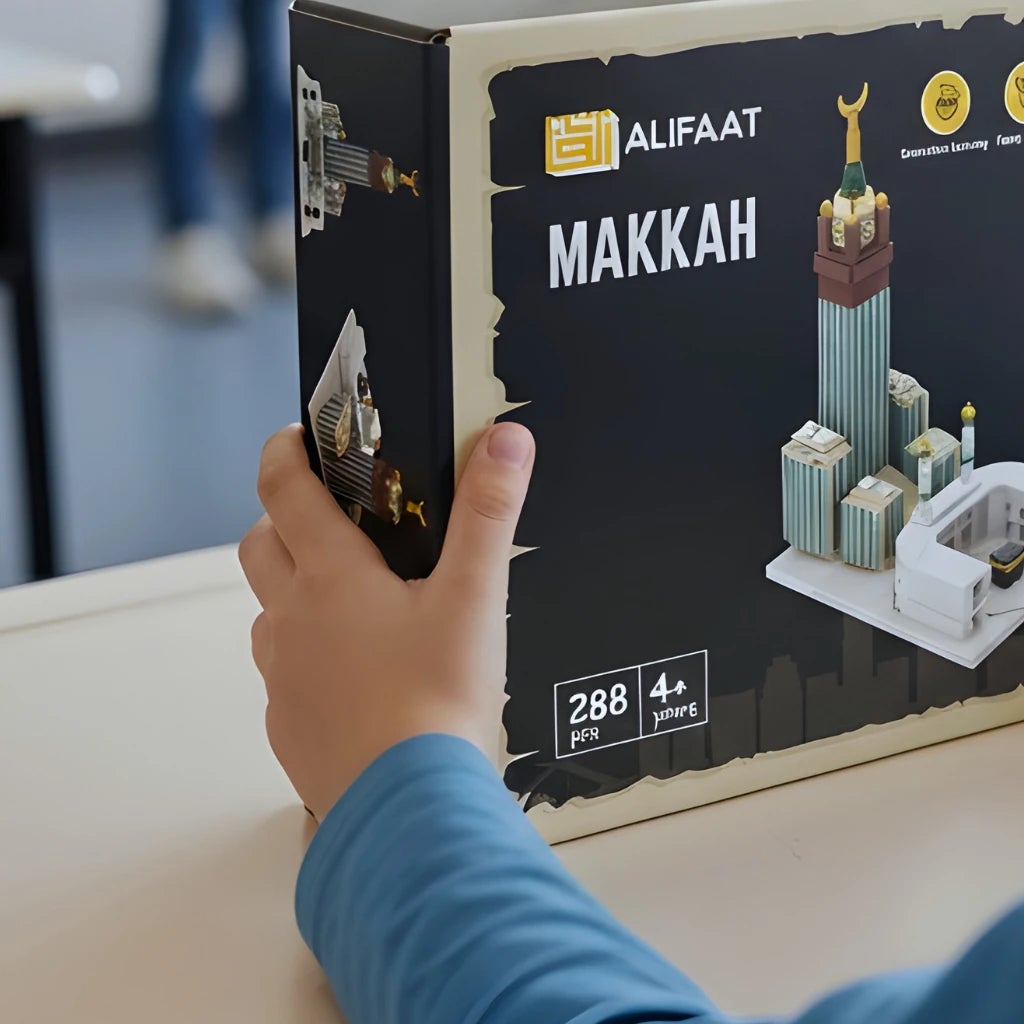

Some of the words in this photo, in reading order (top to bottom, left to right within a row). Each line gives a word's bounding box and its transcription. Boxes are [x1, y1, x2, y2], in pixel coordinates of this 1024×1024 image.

[624, 106, 762, 154] ALIFAAT
[549, 196, 756, 289] MAKKAH
[568, 683, 628, 725] 288
